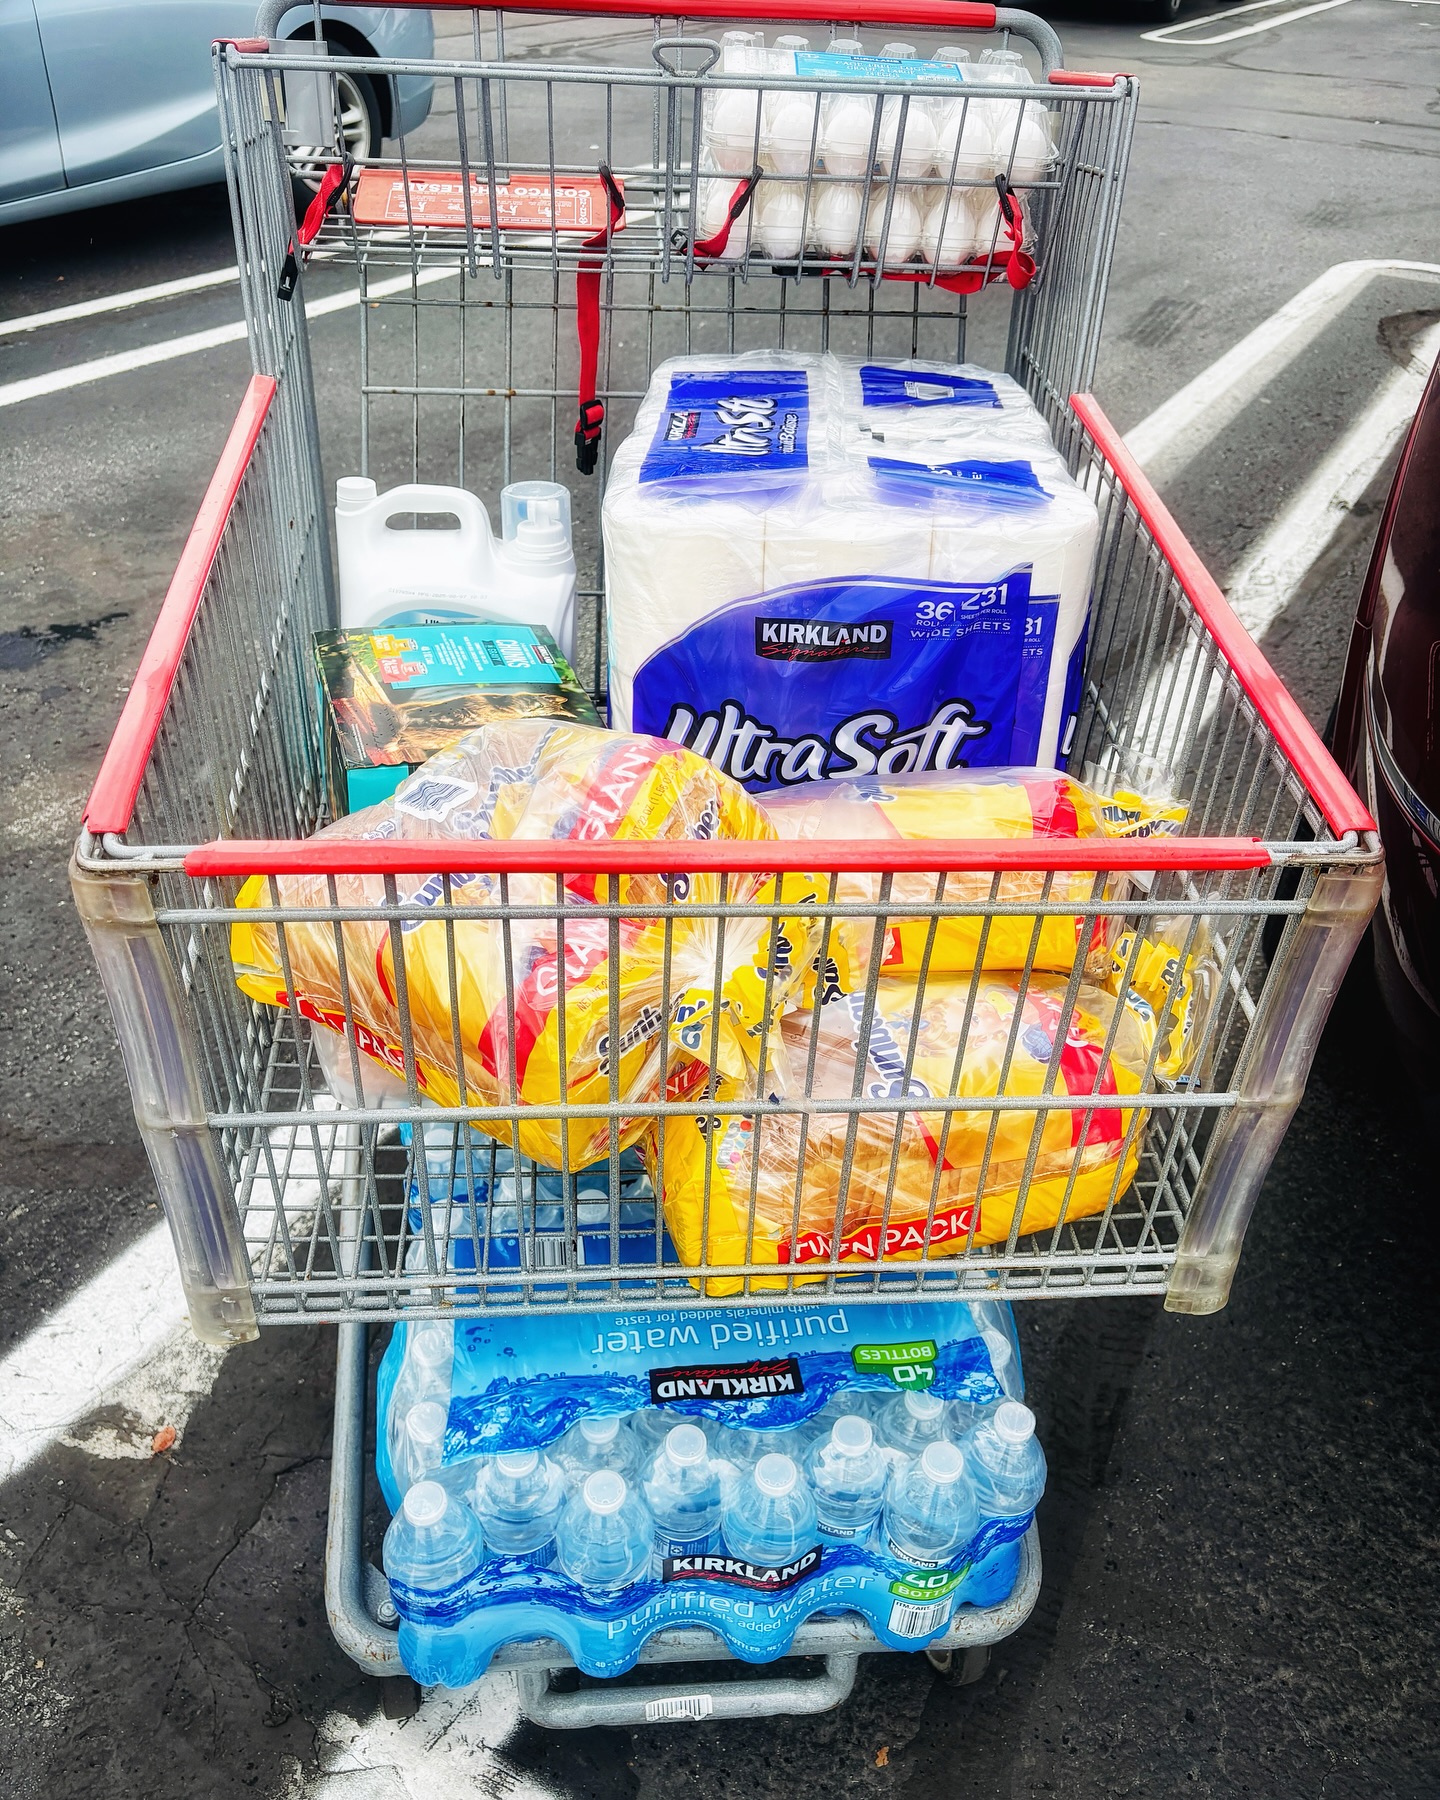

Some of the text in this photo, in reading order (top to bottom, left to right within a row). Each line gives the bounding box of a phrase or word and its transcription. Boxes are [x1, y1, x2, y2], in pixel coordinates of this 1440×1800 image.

[513, 187, 591, 198] COSTCO
[915, 601, 955, 621] 36
[761, 623, 888, 646] KIRKLAND
[910, 621, 1011, 638] WIDE SHEETS
[495, 639, 531, 668] CHUNKS
[761, 642, 886, 662] Signature
[1022, 648, 1044, 657] ETS
[581, 745, 651, 841] GIAN
[357, 1027, 405, 1068] PAC
[790, 1209, 972, 1259] TWN PACK
[615, 1315, 652, 1327] taste
[656, 1311, 677, 1324] for
[680, 1309, 722, 1322] added
[726, 1306, 784, 1320] minerals
[591, 1308, 850, 1355] purified water
[860, 1346, 933, 1361] BOTTLES
[893, 1364, 934, 1383] 40
[656, 1373, 795, 1398] KIRKLAND
[889, 1542, 936, 1569] KIRKLAND
[672, 1552, 817, 1582] KIRKLAND
[905, 1572, 949, 1588] 40
[607, 1574, 875, 1640] purified water
[632, 1590, 845, 1636] with minerals added for taste
[726, 1632, 761, 1652] BOTTLES
